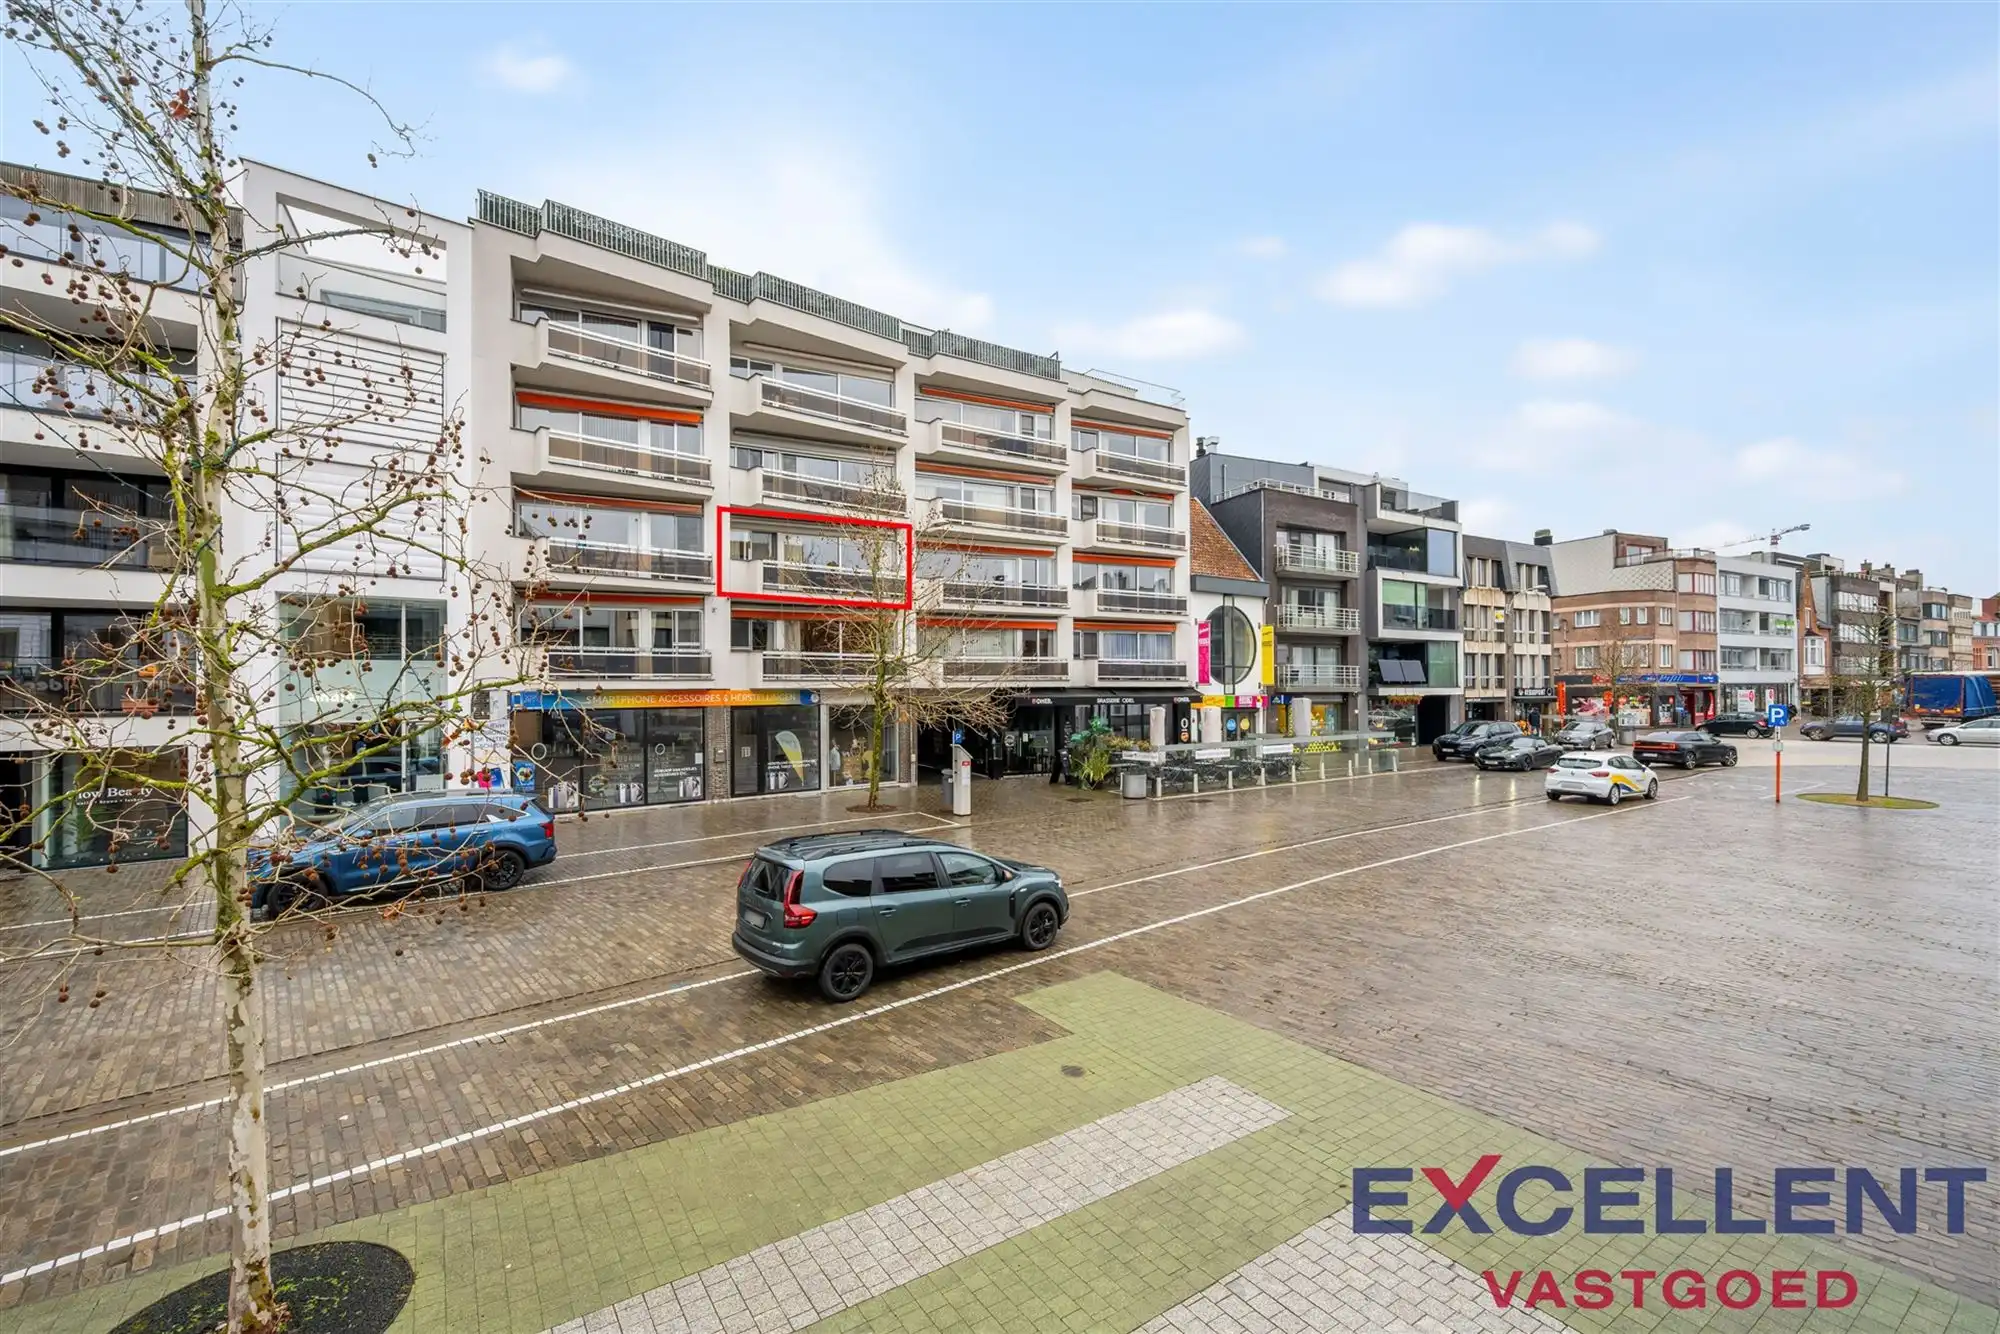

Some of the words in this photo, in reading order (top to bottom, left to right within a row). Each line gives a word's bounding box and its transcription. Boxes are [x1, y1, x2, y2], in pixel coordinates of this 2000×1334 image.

[586, 695, 656, 704] SMARTPHONE
[659, 694, 720, 703] ACCESSOIRES
[1770, 708, 1784, 723] P
